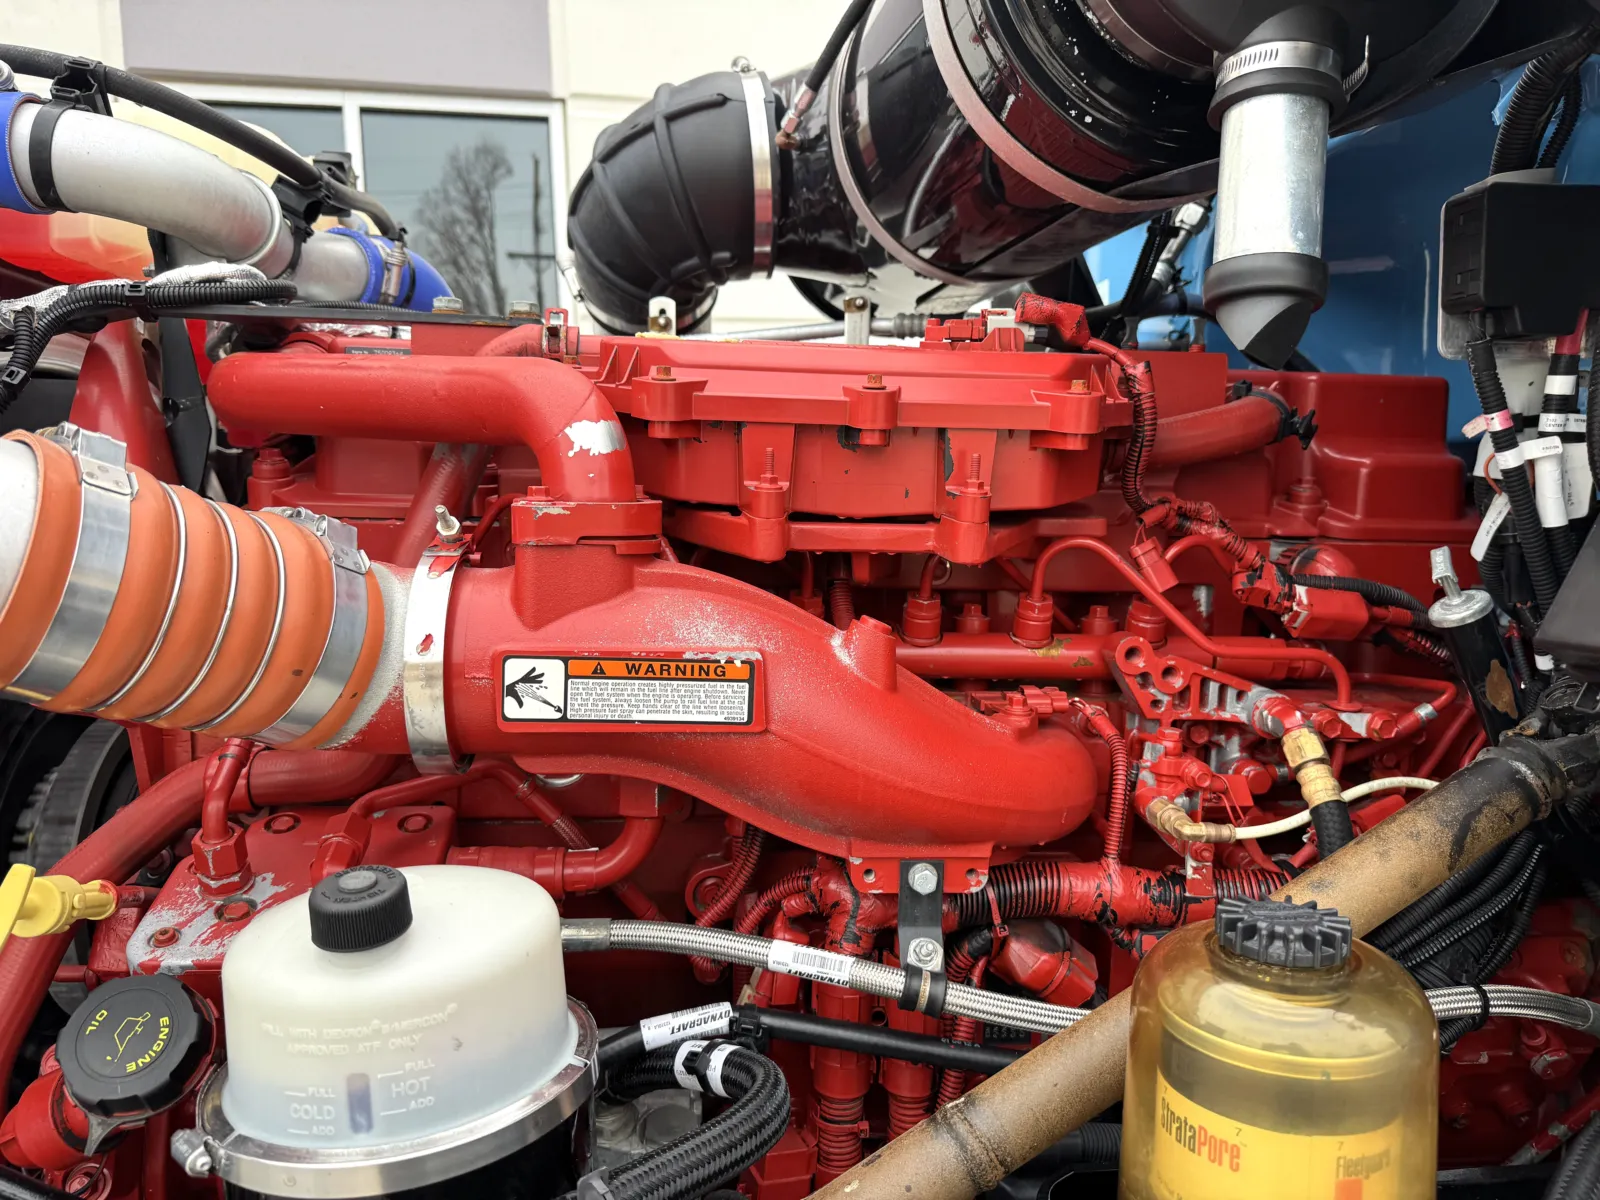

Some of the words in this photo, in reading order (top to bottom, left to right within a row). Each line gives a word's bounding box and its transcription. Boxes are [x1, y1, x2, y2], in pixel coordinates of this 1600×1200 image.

[625, 662, 726, 678] WARNING
[85, 1010, 108, 1034] OIL
[670, 1009, 730, 1035] DYNACRAFT
[288, 1027, 318, 1040] WITH
[126, 1016, 170, 1072] ENGINE
[287, 1042, 349, 1056] APPROVED
[356, 1040, 382, 1054] ATF
[389, 1033, 424, 1050] ONLY
[405, 1058, 435, 1073] FULL
[308, 1087, 336, 1098] FULL
[392, 1076, 430, 1098] HOT
[409, 1096, 436, 1110] ADD
[290, 1104, 335, 1120] COLD
[311, 1126, 335, 1136] ADD
[1160, 1096, 1241, 1172] StrataPore
[1234, 1126, 1242, 1136] 7
[1336, 1149, 1390, 1180] Fleetguard
